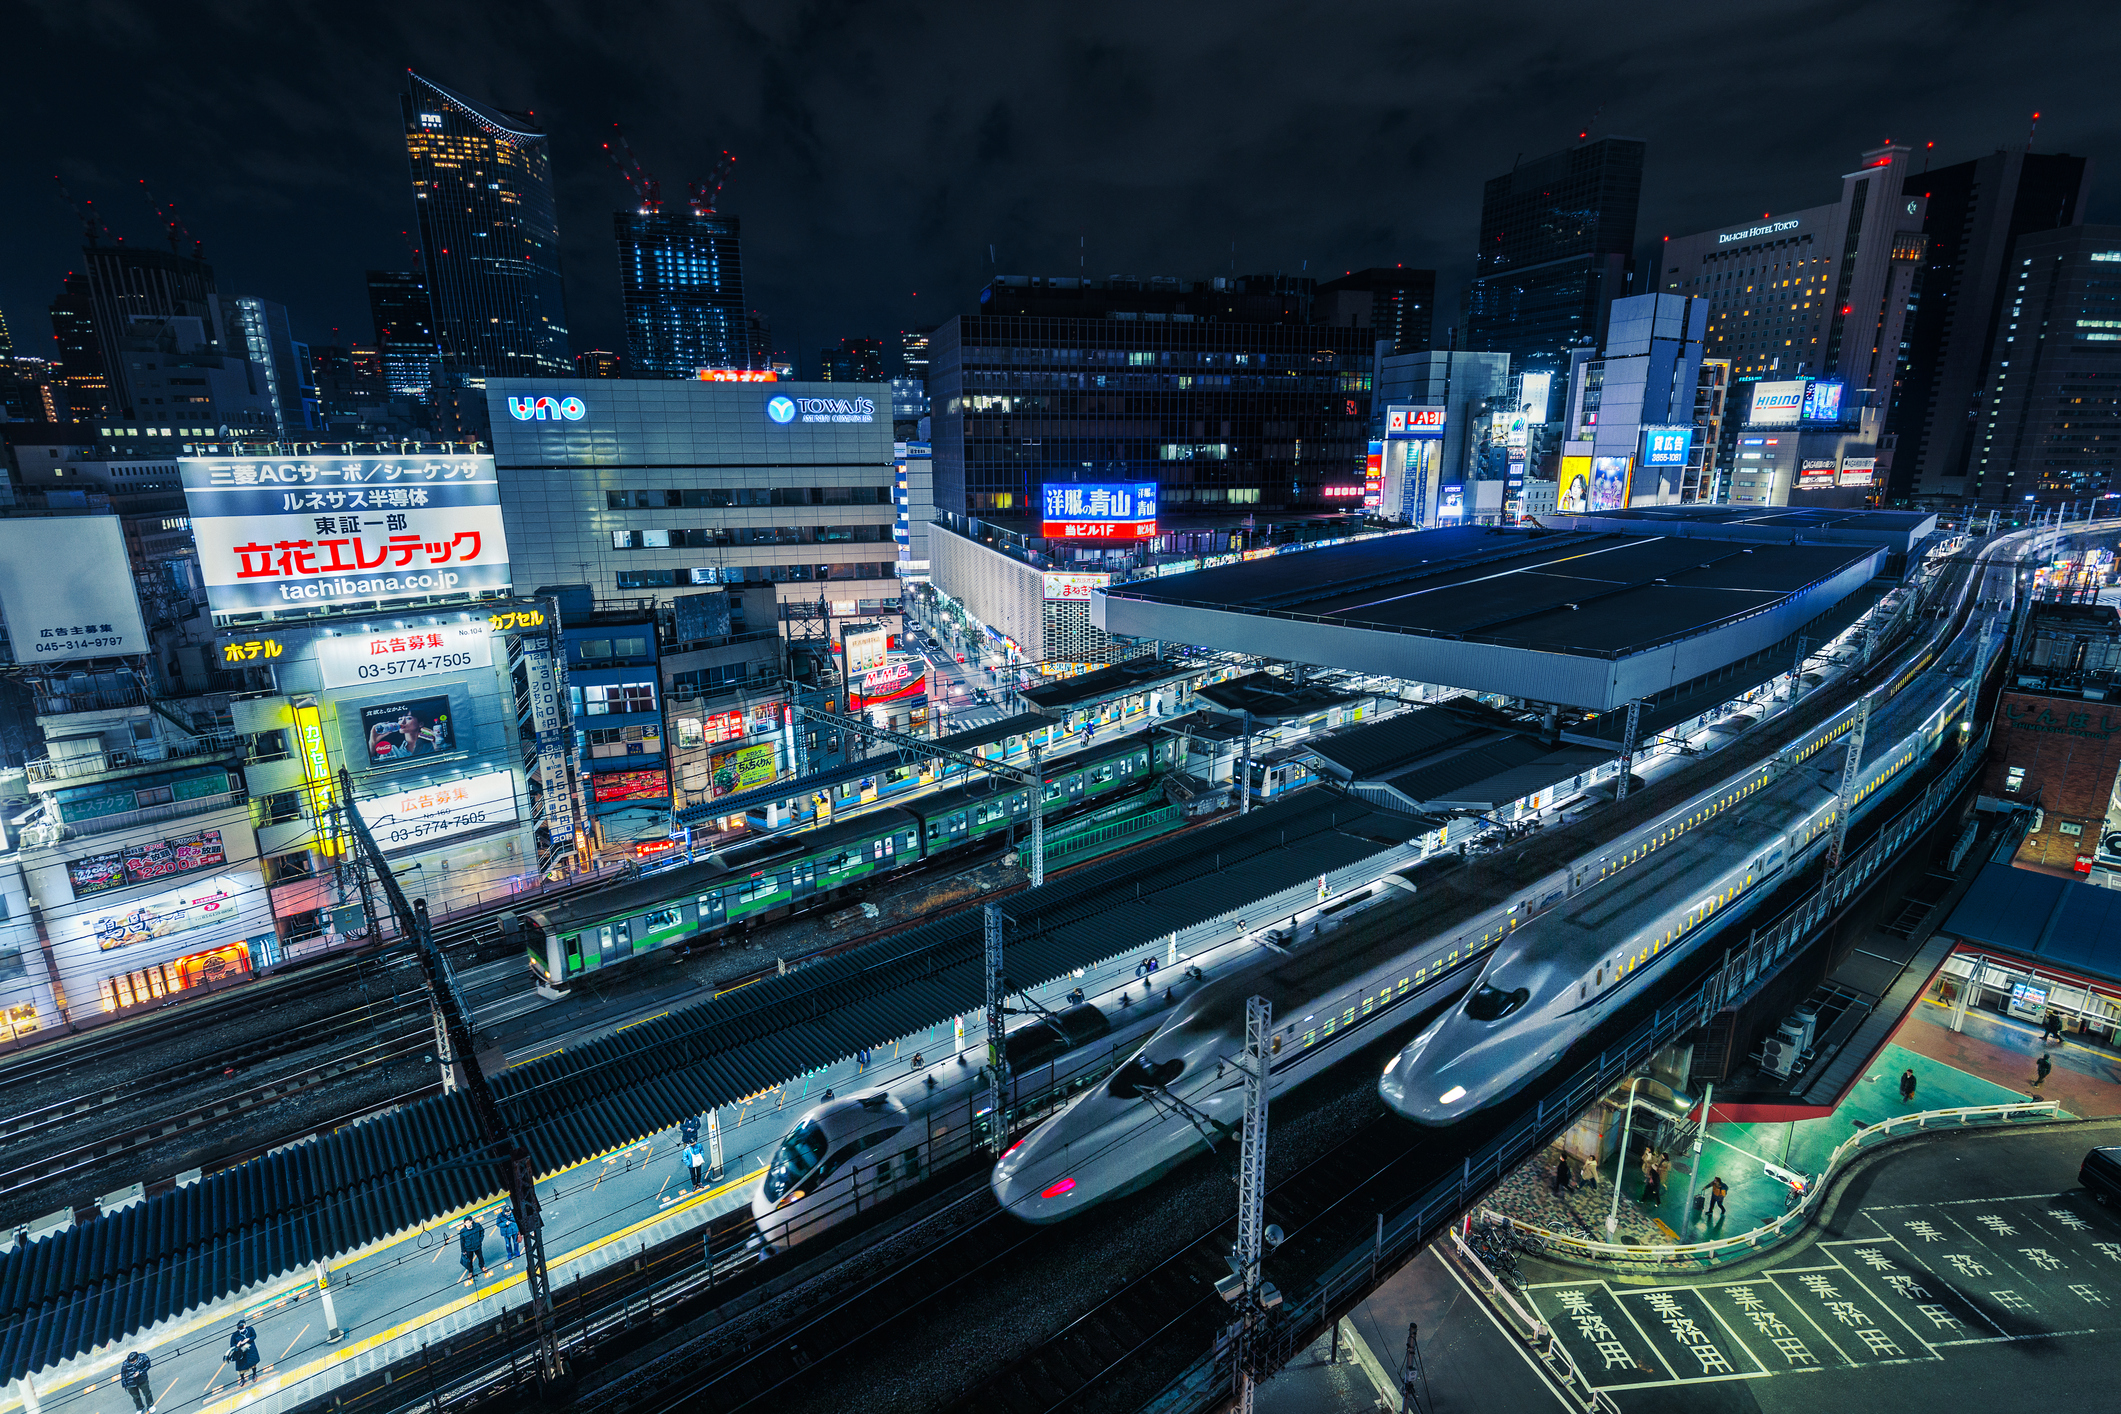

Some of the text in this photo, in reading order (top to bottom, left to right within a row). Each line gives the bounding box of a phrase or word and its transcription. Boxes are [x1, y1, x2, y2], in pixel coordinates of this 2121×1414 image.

[1749, 225, 1773, 237] HOTEL
[1774, 220, 1799, 232] TOKYO
[1756, 395, 1800, 406] HIBINO
[1407, 411, 1444, 425] LABI
[1653, 435, 1684, 451] 貸広告
[283, 488, 429, 512] ルネサス半導体
[1046, 488, 1131, 516] 洋服の青山
[1137, 487, 1156, 499] 洋服の
[1137, 500, 1156, 517] 青山
[314, 514, 408, 536] 東証一部
[1065, 524, 1116, 536] 当ビル1F
[233, 531, 482, 579] 立花エレテック
[278, 570, 459, 601] tachibana.co.jp
[1063, 584, 1092, 597] まねき
[39, 623, 114, 639] 広告主募集
[488, 609, 545, 632] カプセル
[35, 635, 123, 653] 045-314-9797
[224, 638, 283, 662] ホテル
[369, 632, 445, 657] 広告募集
[358, 651, 472, 680] 03-5774-7505
[864, 664, 912, 688] M.M.C.
[875, 680, 902, 694] COFFEE
[2006, 703, 2121, 733] しんばし
[2012, 721, 2110, 741] SHIMBASHI STATION
[75, 794, 134, 813] エステクラブ
[400, 787, 469, 813] 広告募集
[390, 810, 486, 843] 03-5774-7505
[126, 849, 173, 871] 食べ放題
[176, 845, 222, 858] 飲み放題
[1904, 1220, 2039, 1314] 業務用
[1854, 1248, 1967, 1330] 業務用
[1724, 1286, 1821, 1366] 業務用
[1799, 1274, 1904, 1356] 業務用
[1555, 1290, 1640, 1370] 業務用
[1644, 1292, 1735, 1375] 業務用
